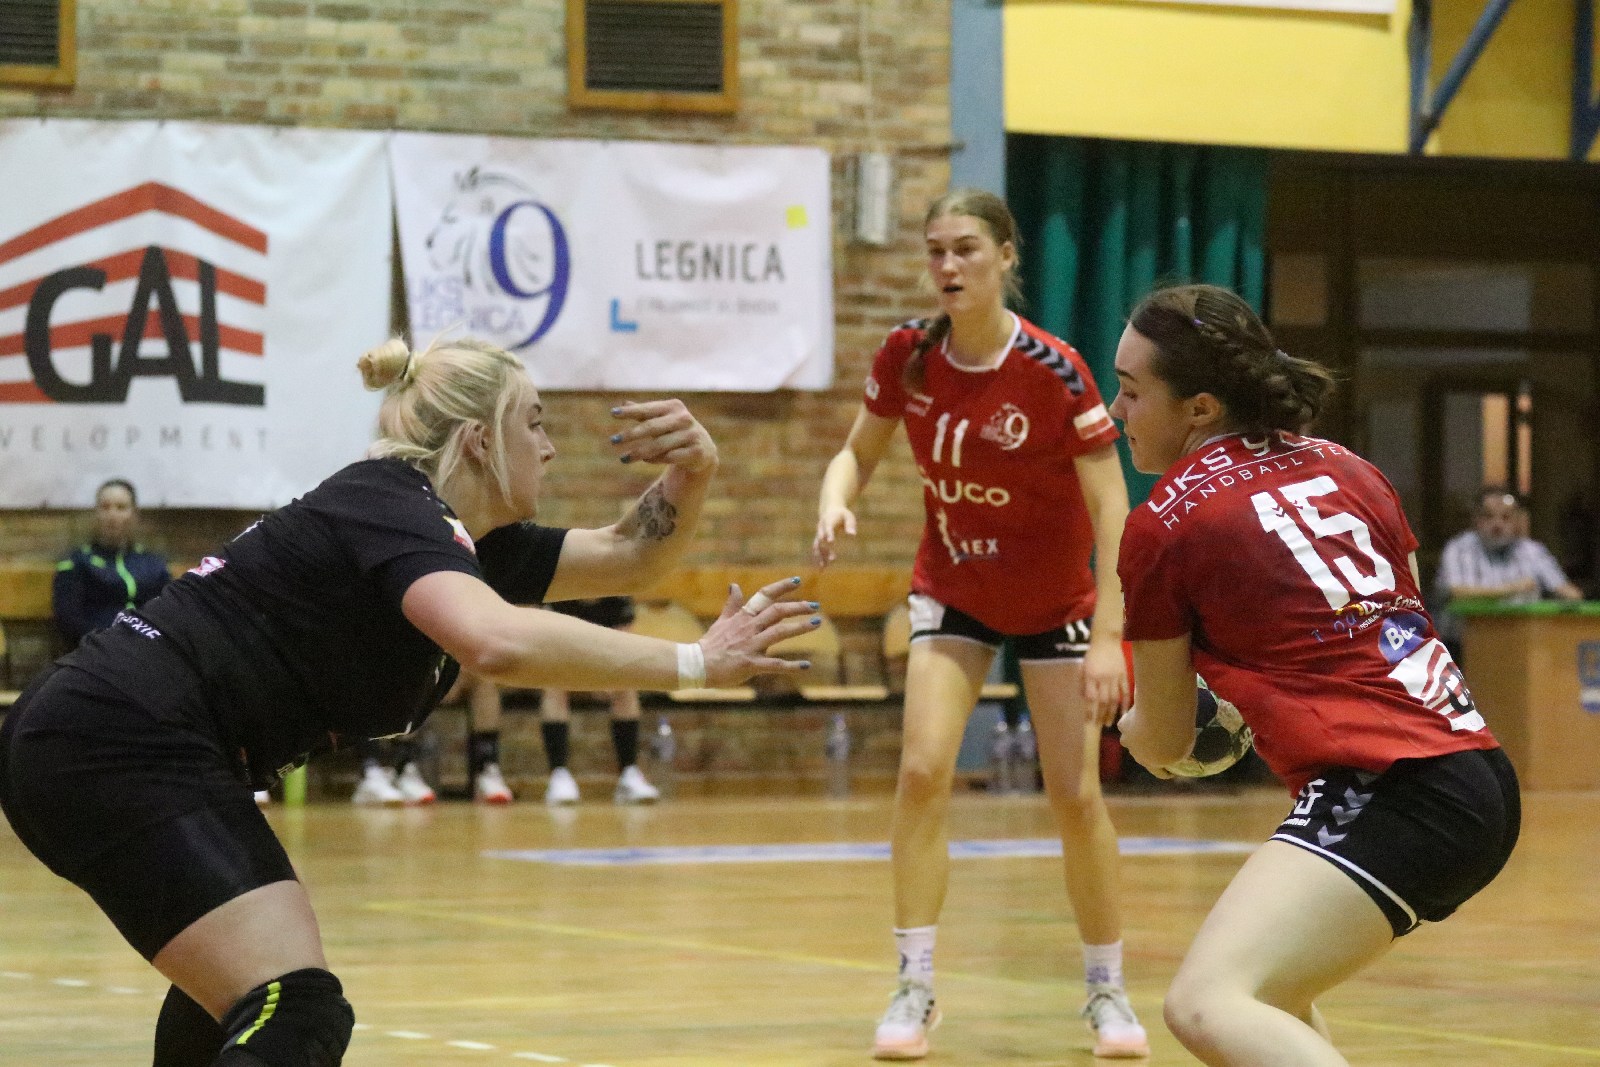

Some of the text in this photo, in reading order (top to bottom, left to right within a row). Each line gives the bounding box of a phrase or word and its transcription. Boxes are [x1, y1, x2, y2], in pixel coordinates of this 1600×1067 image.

[490, 199, 570, 350] 9
[635, 239, 786, 284] LEGNICA
[26, 245, 267, 406] GAL
[932, 412, 969, 468] 11
[1148, 446, 1233, 513] UKS
[1163, 457, 1302, 530] HANDBALL
[1250, 475, 1396, 611] 15
